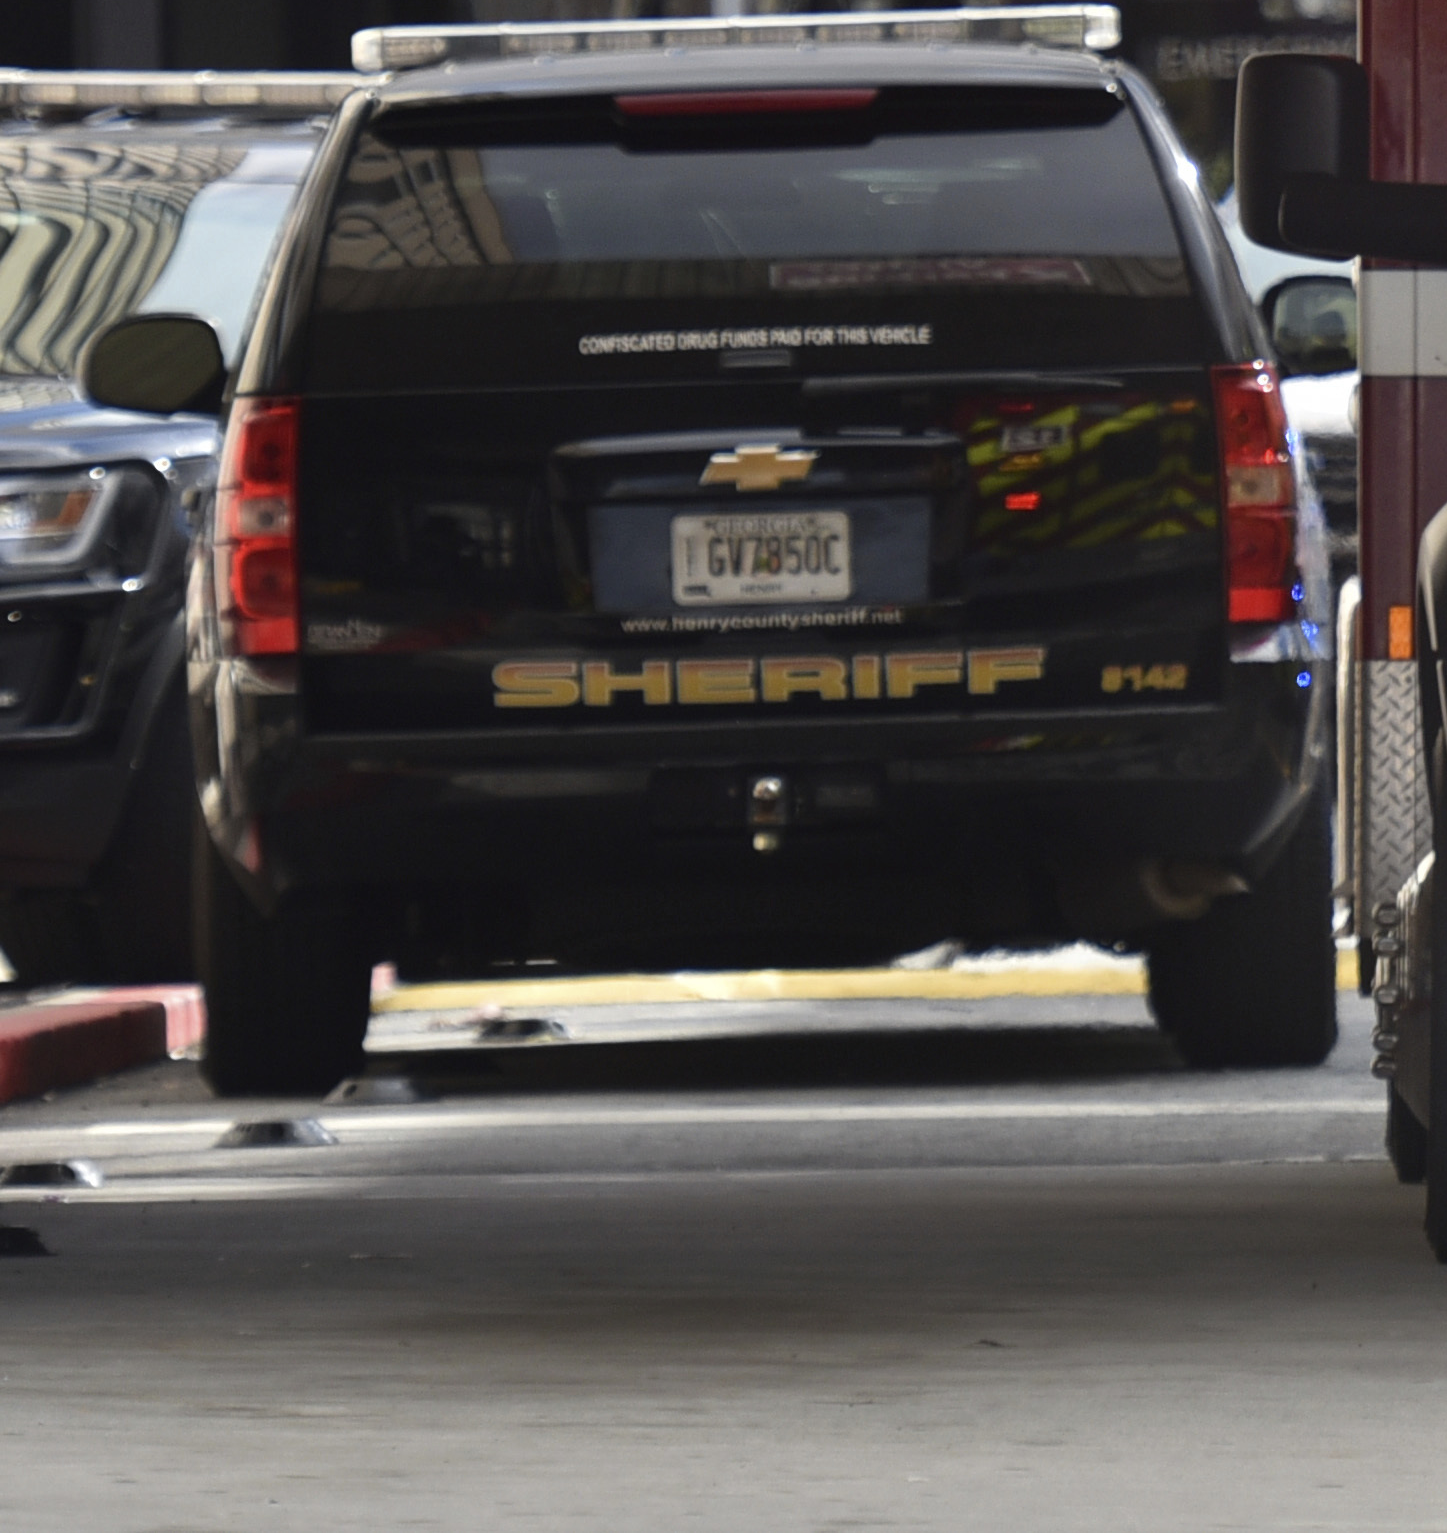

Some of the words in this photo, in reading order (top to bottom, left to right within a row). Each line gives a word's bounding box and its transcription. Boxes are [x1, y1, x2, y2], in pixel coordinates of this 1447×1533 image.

[578, 332, 677, 355] CONFISCATED
[677, 330, 718, 350] DRUG
[719, 328, 769, 349] FUNDS
[769, 326, 803, 347] PAID
[804, 325, 834, 346] FOR
[835, 325, 869, 345] THIS
[870, 323, 932, 345] VEHICLE
[708, 534, 841, 577] GV7850C
[620, 606, 903, 634] www.henrycountysheriff.net
[492, 648, 1044, 707] SHERIFF
